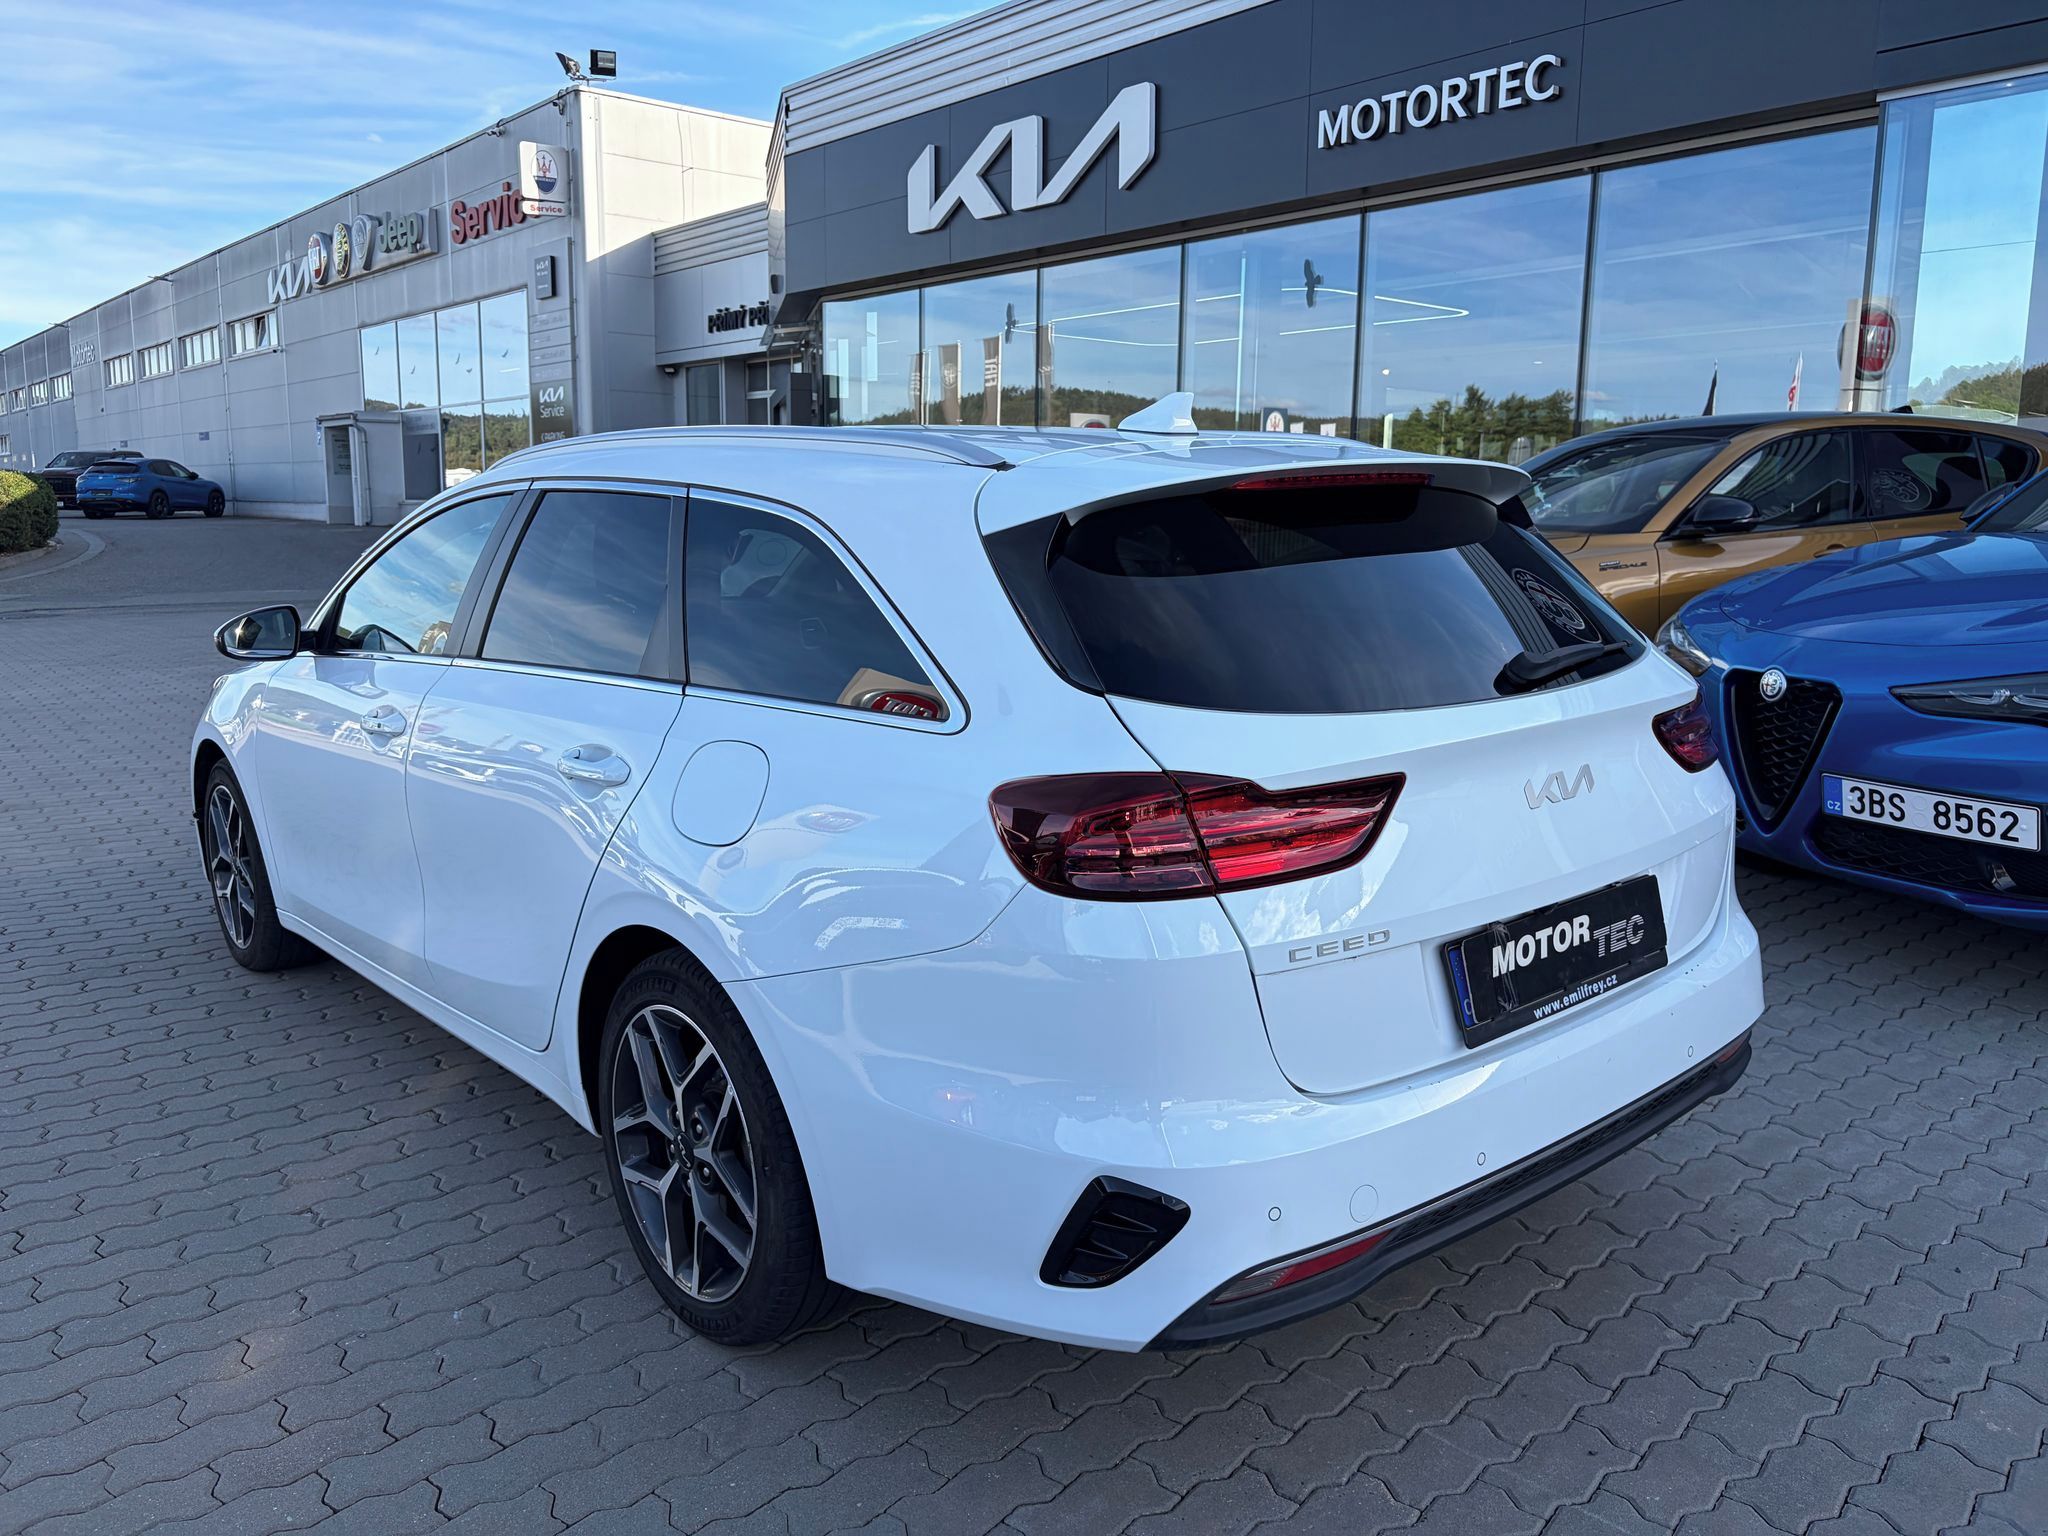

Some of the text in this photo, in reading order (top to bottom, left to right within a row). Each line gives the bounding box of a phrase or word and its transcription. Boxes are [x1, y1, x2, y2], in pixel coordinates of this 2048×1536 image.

[1317, 54, 1562, 150] MOTORTEC
[908, 81, 1158, 234] KIA
[451, 181, 541, 245] Servic
[530, 204, 563, 213] Service
[377, 210, 424, 254] Jeep
[708, 304, 747, 333] PŘÍMÝ
[539, 386, 564, 403] KIA
[540, 404, 565, 419] Service
[1524, 763, 1595, 810] KIA
[1827, 800, 1841, 812] CZ
[1849, 786, 2020, 843] 3BS 8562
[1289, 928, 1391, 963] CEED
[1492, 914, 1645, 979] MOTOR TEC
[1533, 972, 1619, 1020] www.emilfrey.cz
